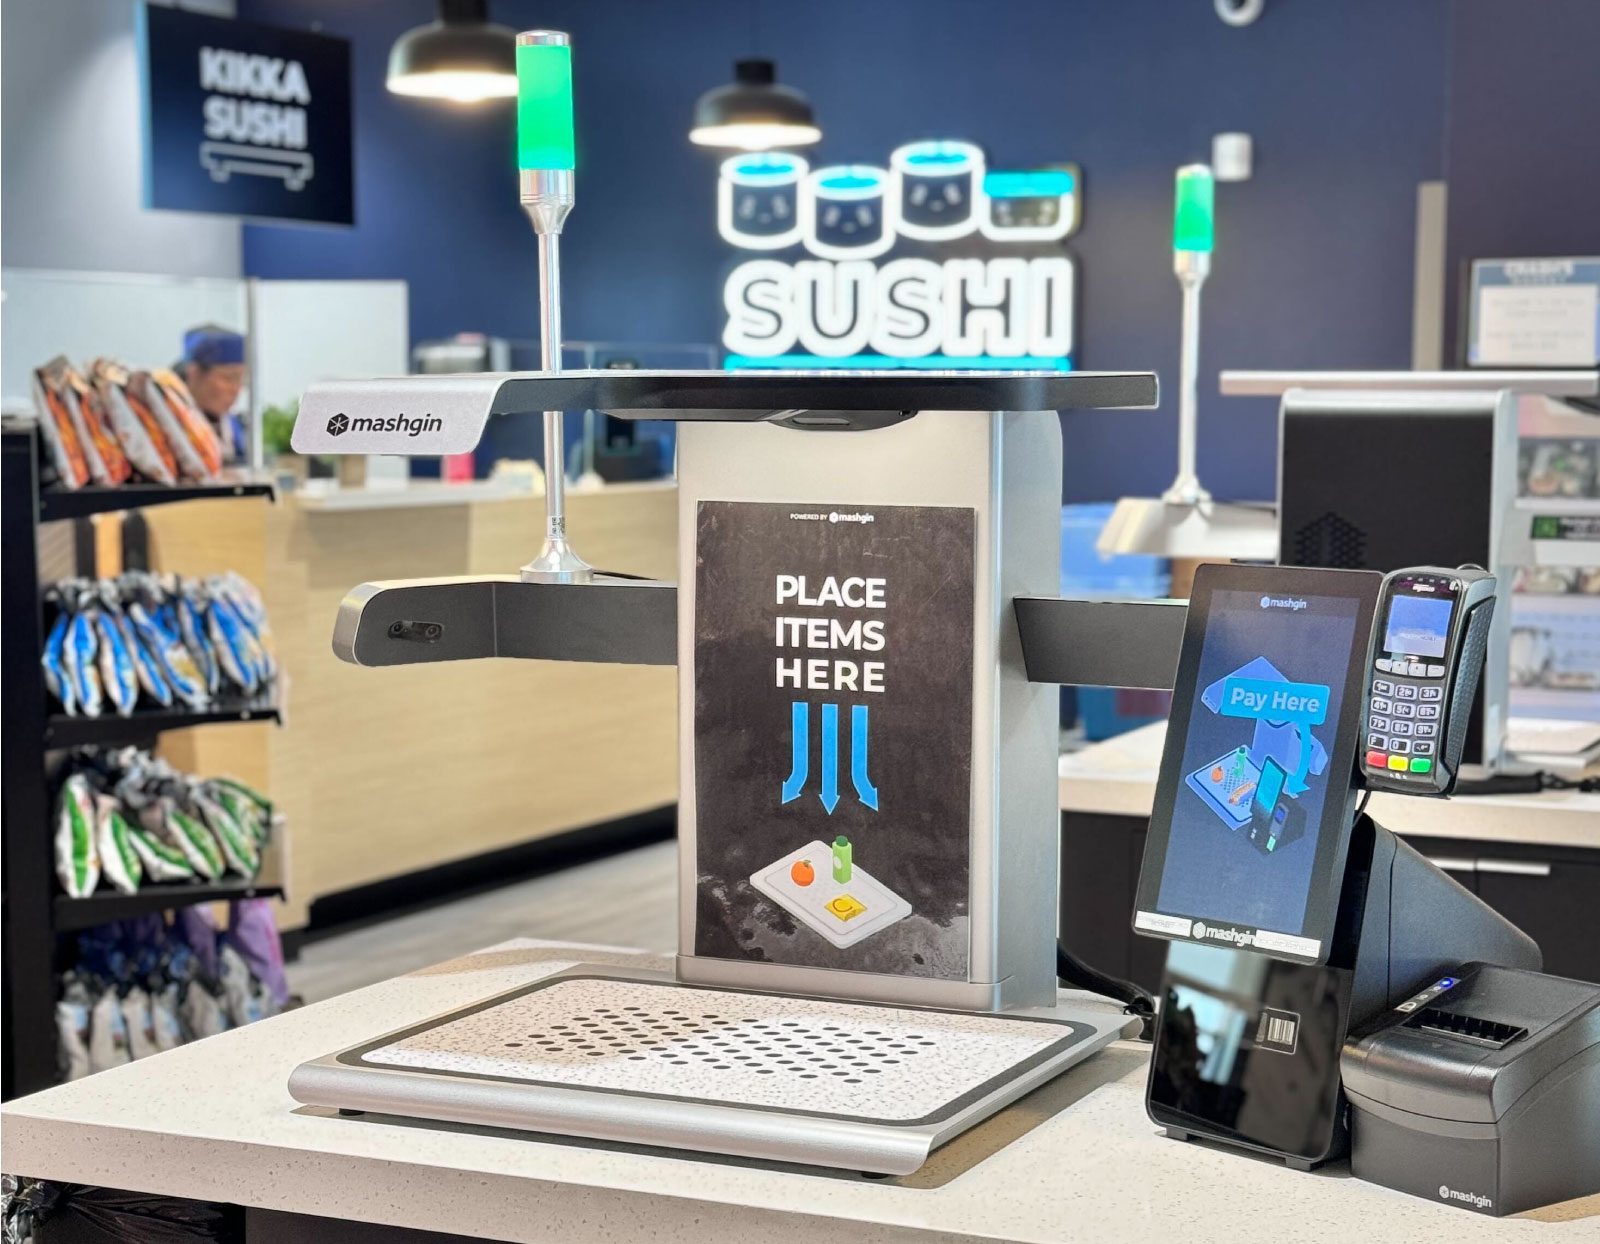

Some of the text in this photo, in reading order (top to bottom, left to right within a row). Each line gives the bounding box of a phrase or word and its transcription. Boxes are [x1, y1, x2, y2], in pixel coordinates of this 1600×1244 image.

[199, 46, 312, 106] KIKKA
[203, 95, 308, 150] SUSHI
[729, 263, 1067, 354] SUSHI
[351, 413, 443, 437] mashgin
[839, 513, 875, 524] mashgin
[776, 574, 887, 609] PLACE
[1270, 598, 1307, 611] mashgin
[775, 616, 886, 652] ITEMS
[776, 657, 885, 693] HERE
[1230, 687, 1320, 713] Pay Here
[1206, 927, 1256, 947] mashgin
[1449, 1190, 1492, 1208] mashgin
